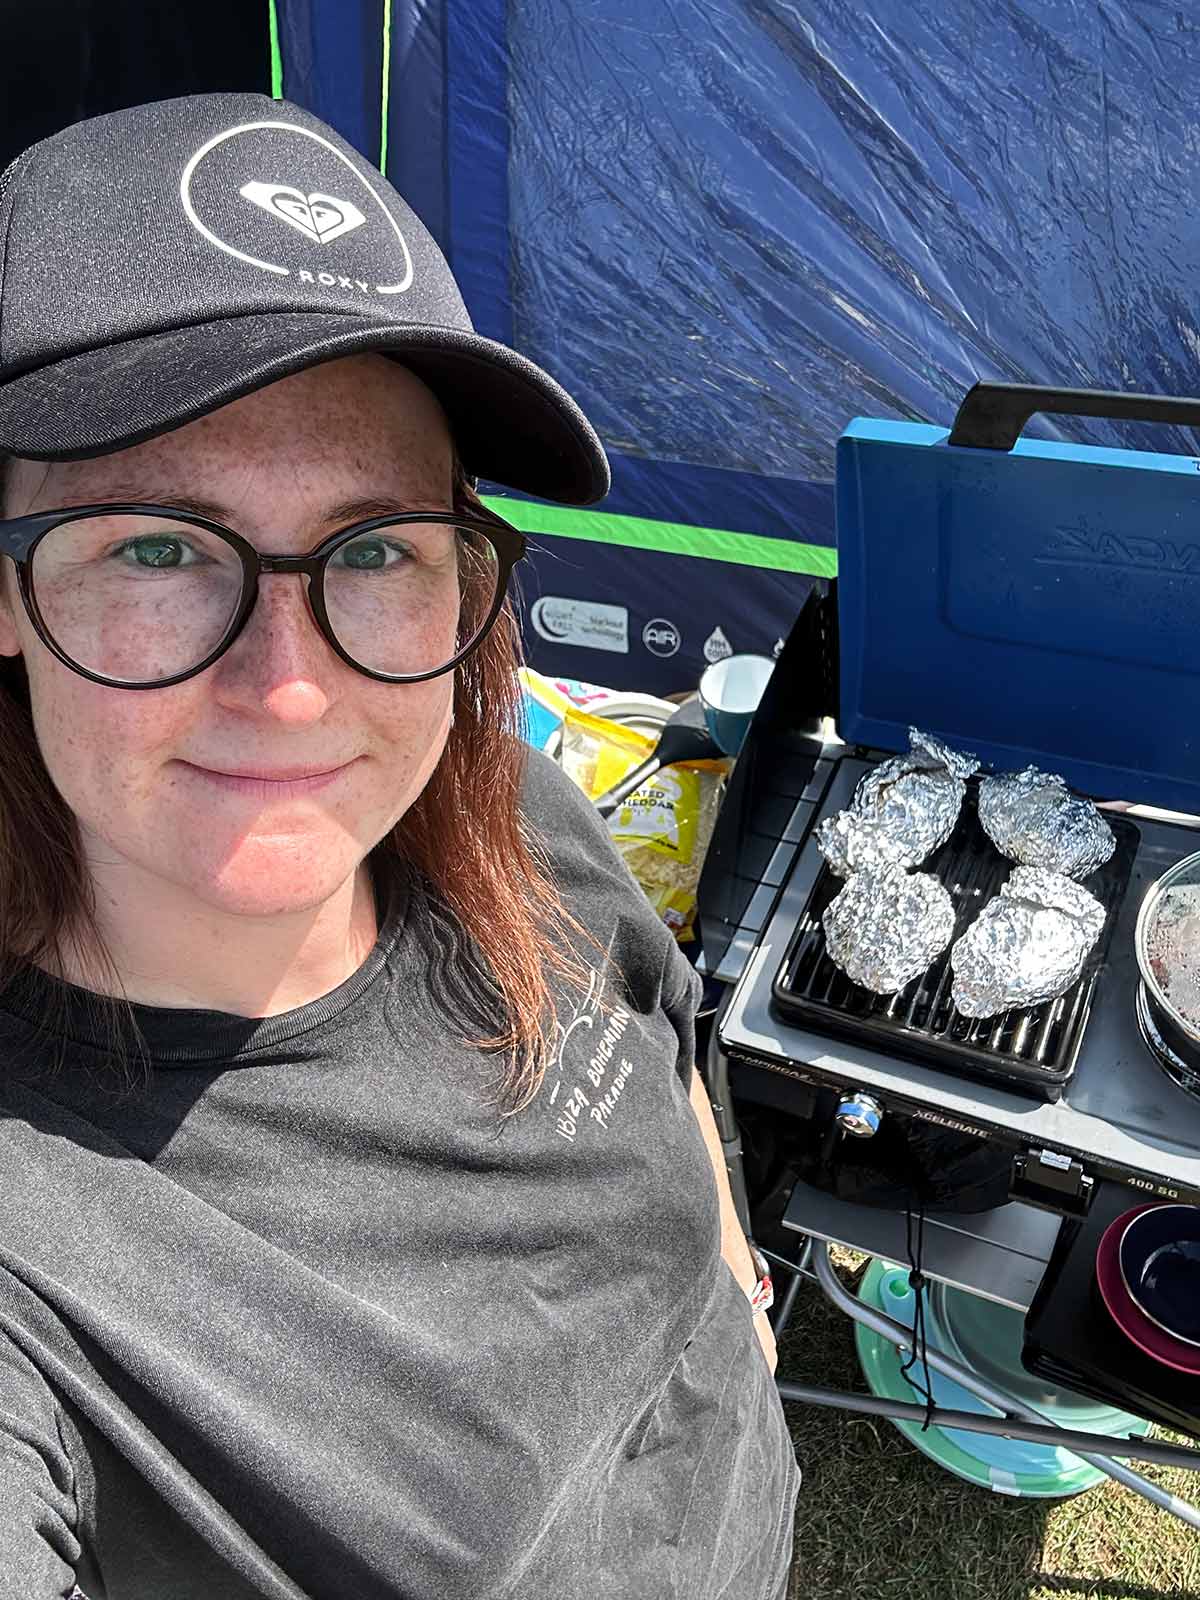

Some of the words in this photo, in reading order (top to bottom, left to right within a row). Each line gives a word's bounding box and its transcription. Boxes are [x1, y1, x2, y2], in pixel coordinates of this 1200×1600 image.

[299, 270, 369, 294] ROXY
[630, 789, 665, 799] ATED
[623, 798, 675, 811] HEDDAR
[555, 1087, 590, 1142] IBIZA
[587, 1006, 630, 1088] BOHEMIAN
[1127, 1177, 1155, 1191] 400
